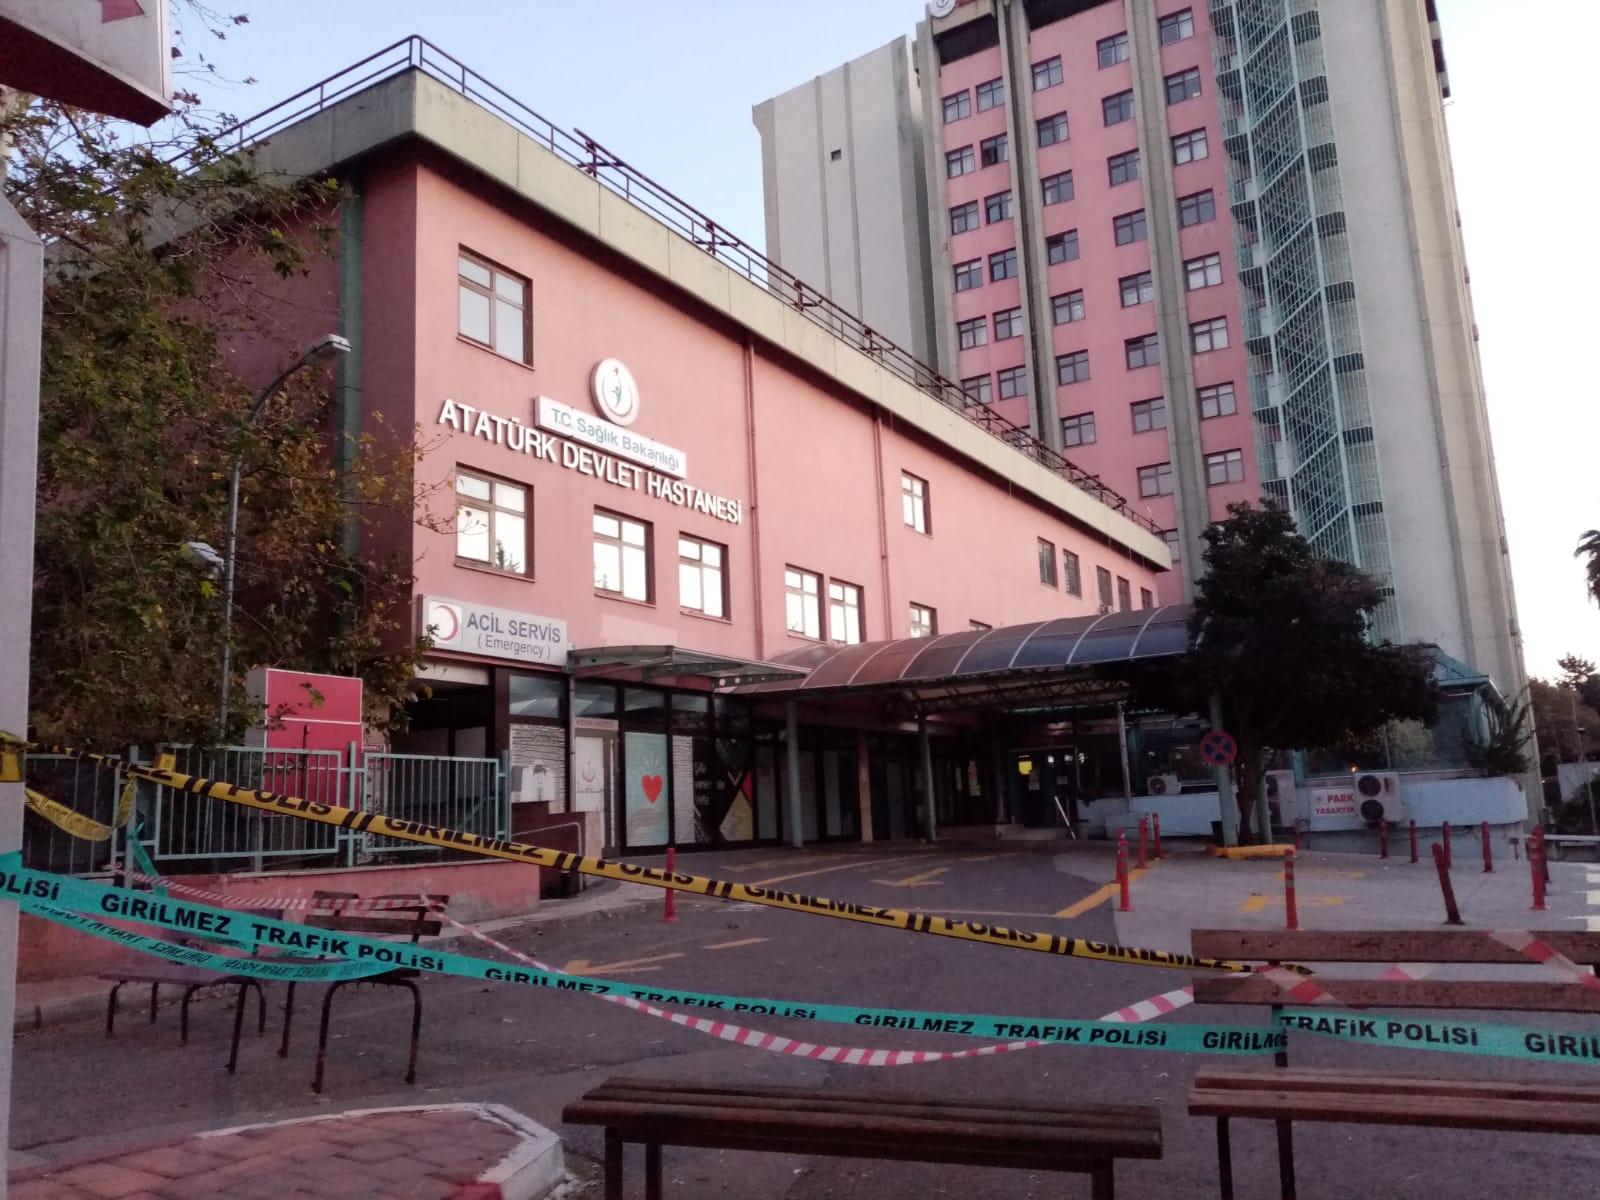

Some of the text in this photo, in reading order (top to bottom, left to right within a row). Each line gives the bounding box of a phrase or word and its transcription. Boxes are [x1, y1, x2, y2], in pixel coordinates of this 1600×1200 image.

[439, 398, 741, 524] ATATÜRK DEVLET HASTANESİ
[551, 408, 679, 471] T.C. Sağlık Bakanlığı
[467, 611, 561, 643] ACİL SERVİS
[1327, 794, 1355, 803] PARK
